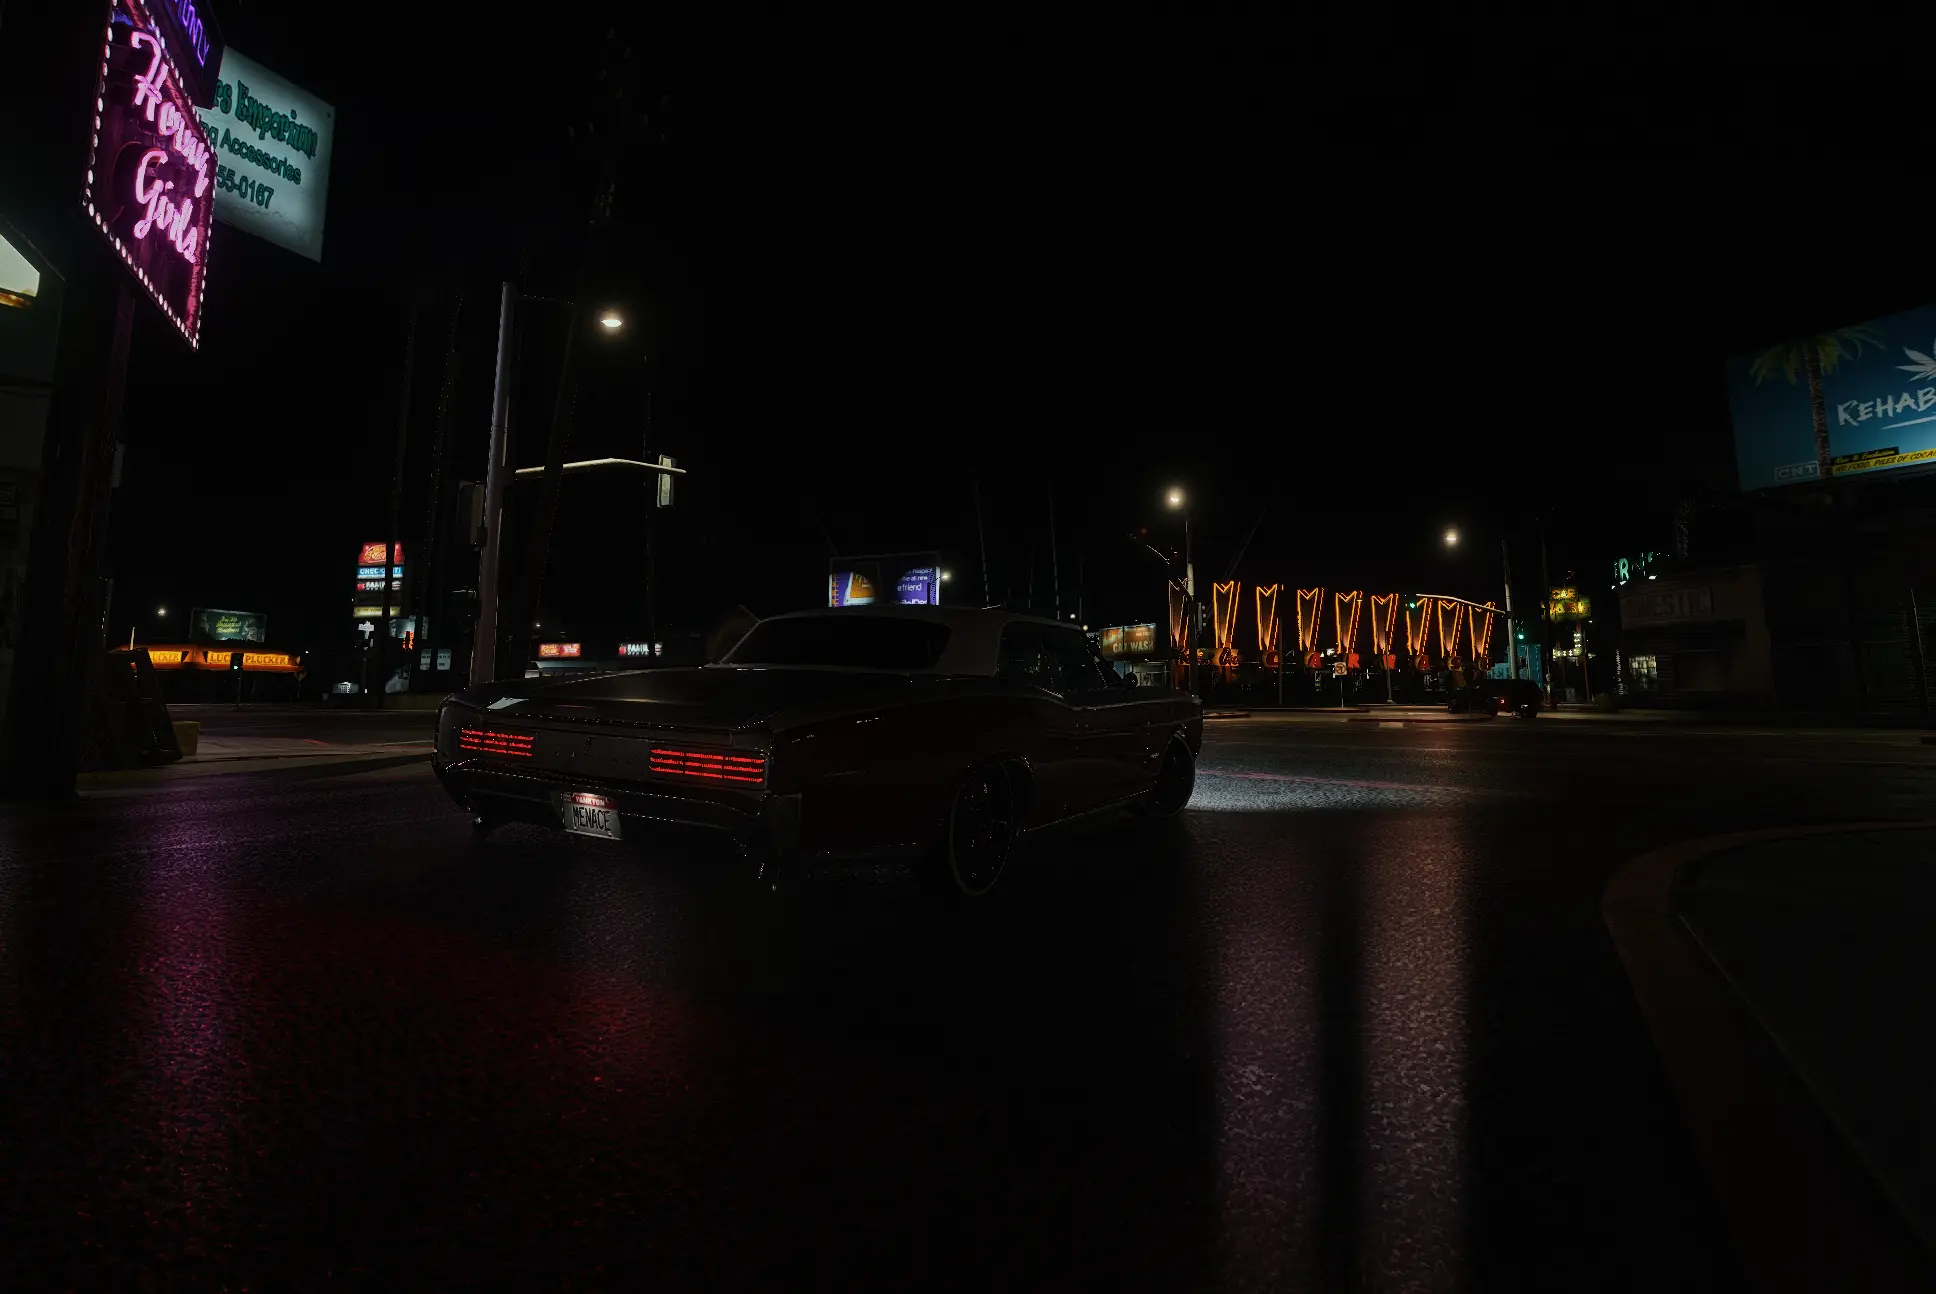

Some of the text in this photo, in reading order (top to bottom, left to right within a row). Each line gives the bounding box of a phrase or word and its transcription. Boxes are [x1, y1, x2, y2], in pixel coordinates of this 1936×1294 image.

[235, 80, 318, 160] Emporium
[220, 128, 302, 185] Accessories
[216, 164, 274, 209] 55-0167
[134, 150, 198, 263] Girls
[1836, 386, 1936, 427] REHAB
[1777, 463, 1816, 480] CNT
[1897, 454, 1909, 463] OF
[1131, 640, 1154, 652] WASH
[246, 655, 286, 665] PLUCKER
[575, 796, 605, 806] YANKTON
[572, 805, 612, 832] MENACE
